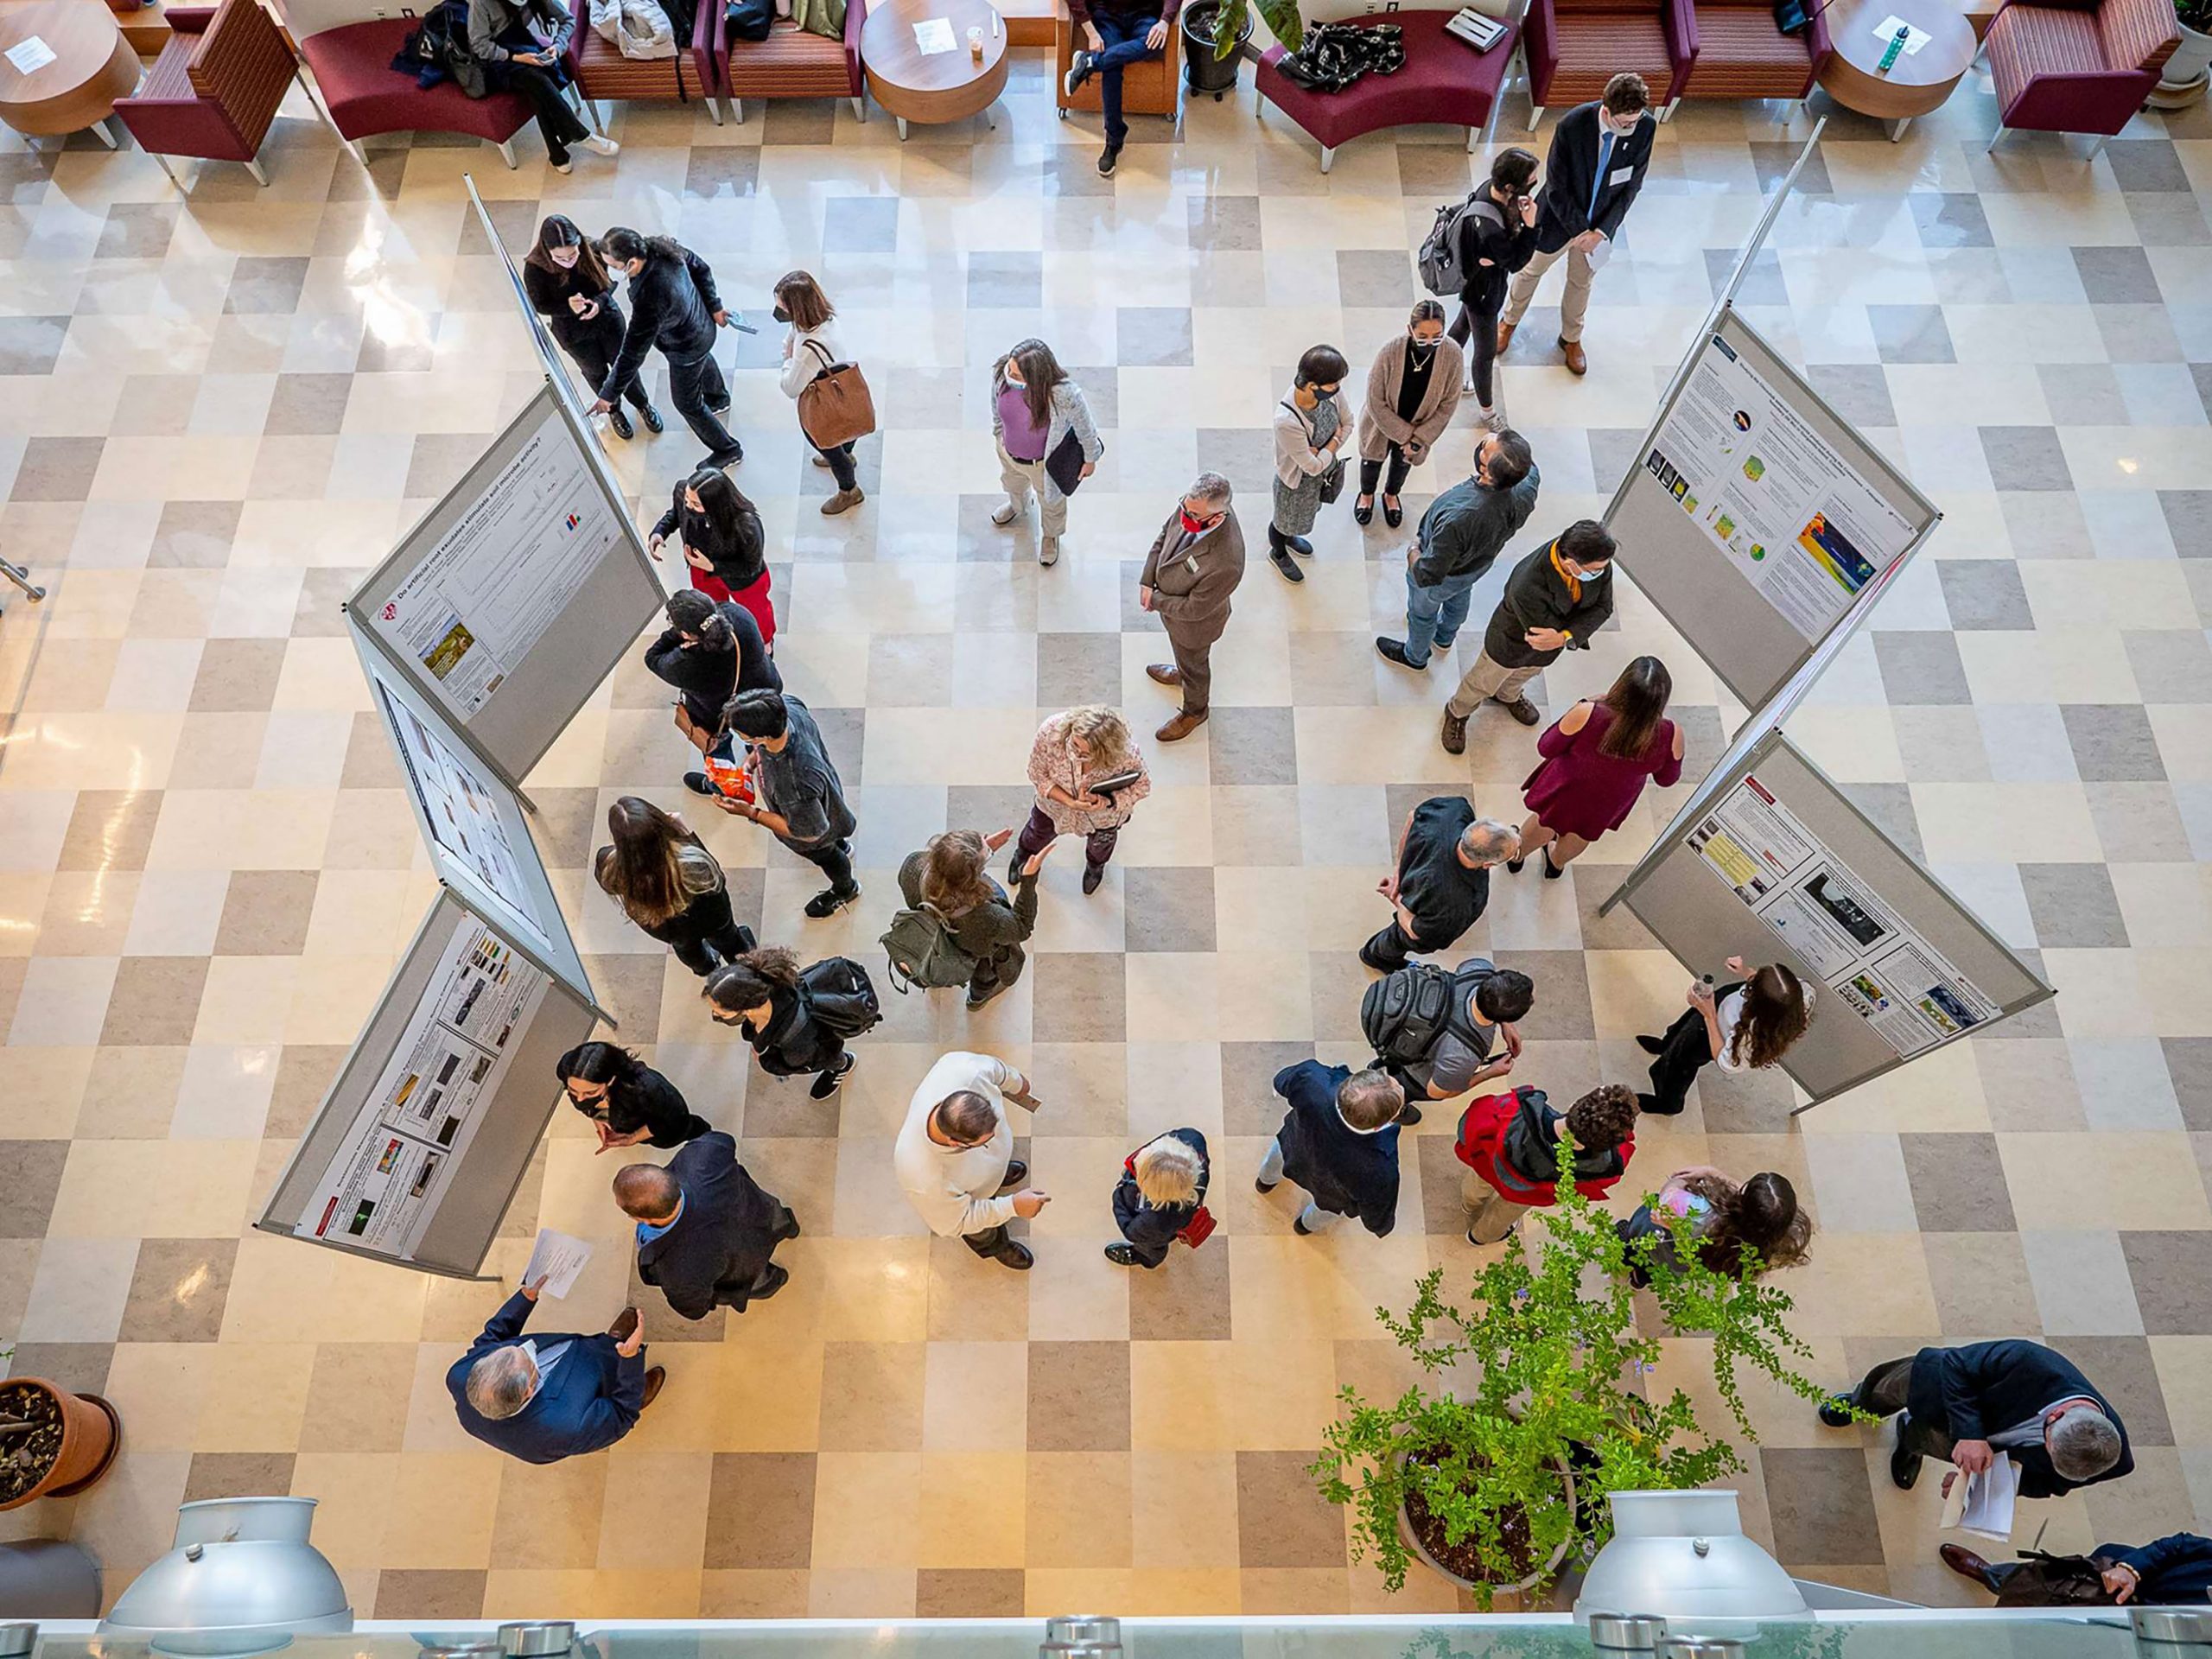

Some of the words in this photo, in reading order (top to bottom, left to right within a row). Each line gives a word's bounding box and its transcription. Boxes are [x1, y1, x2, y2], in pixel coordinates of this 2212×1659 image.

[397, 587, 407, 600] Do
[405, 562, 429, 590] artificial
[428, 550, 442, 565] root
[439, 522, 466, 552] exudates
[463, 495, 489, 525] stimulate
[487, 484, 499, 498] soil
[498, 460, 520, 487] microbe
[518, 435, 542, 463] activity?
